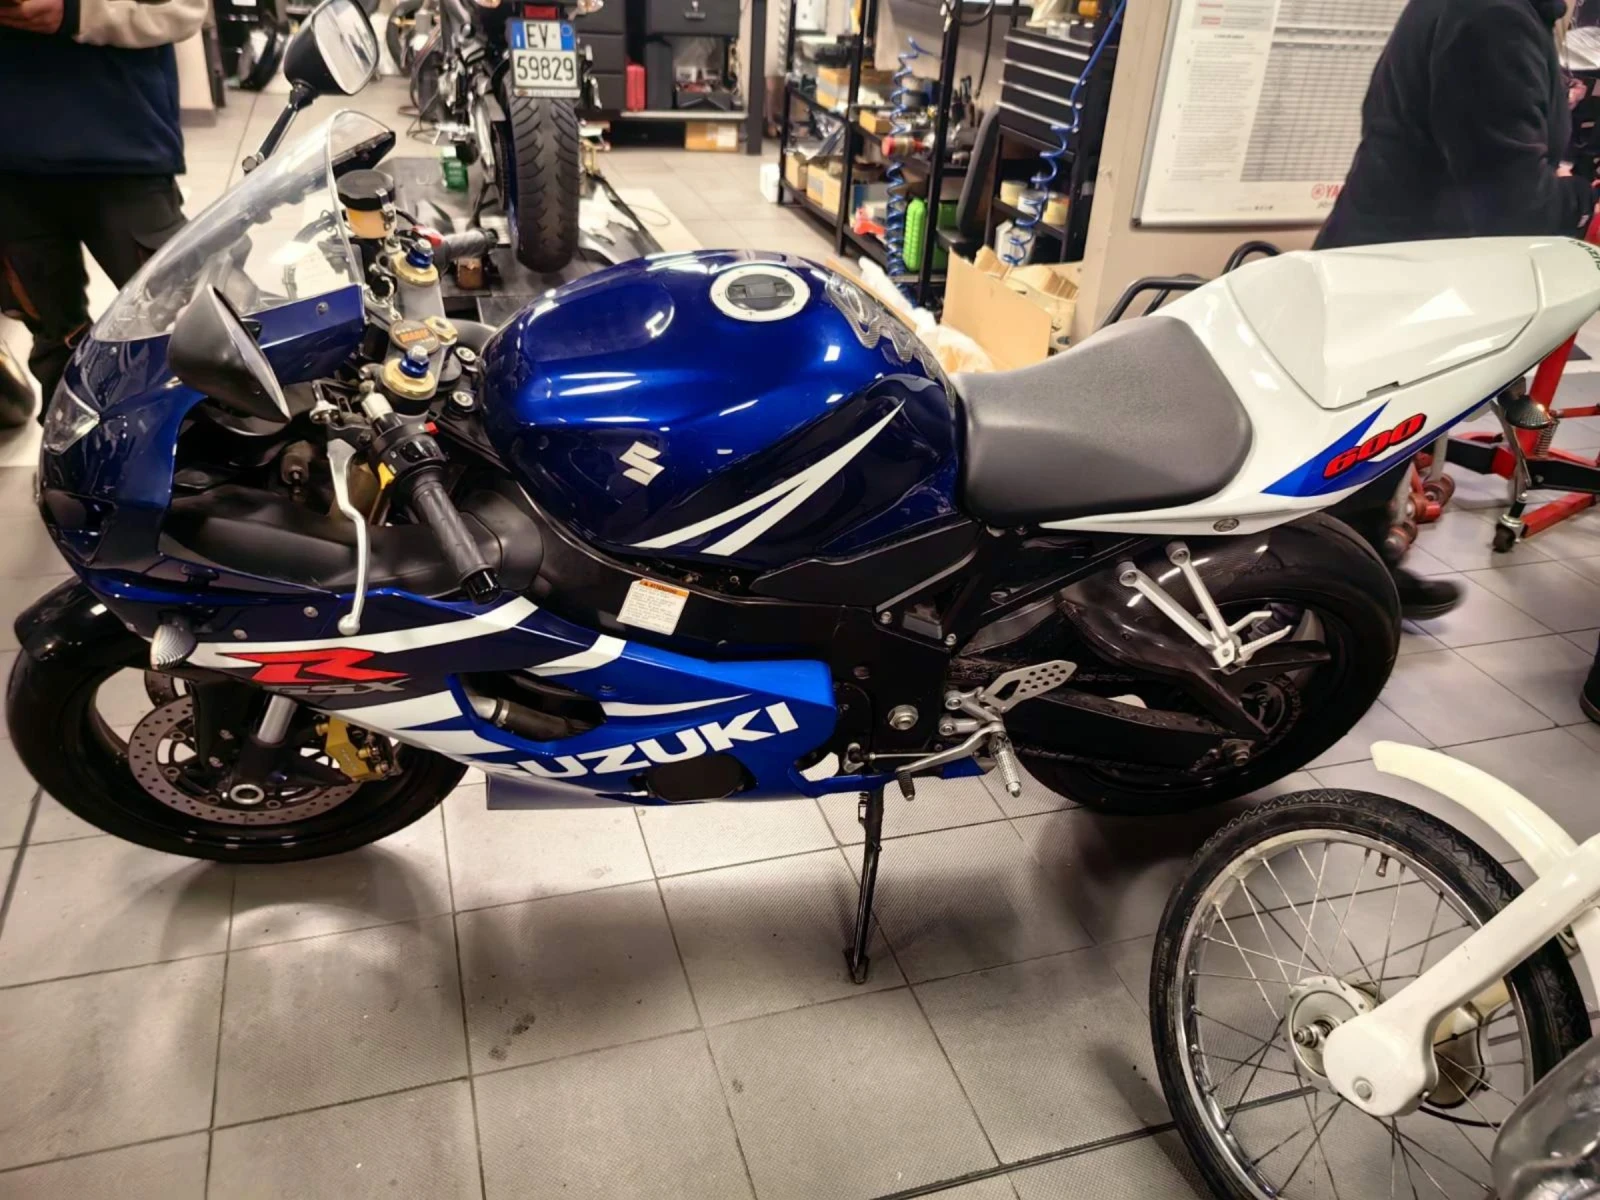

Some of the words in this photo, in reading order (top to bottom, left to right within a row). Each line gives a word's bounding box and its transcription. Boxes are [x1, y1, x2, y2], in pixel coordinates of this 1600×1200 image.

[526, 23, 548, 49] EV
[517, 56, 575, 81] 59829
[1323, 412, 1427, 480] 600
